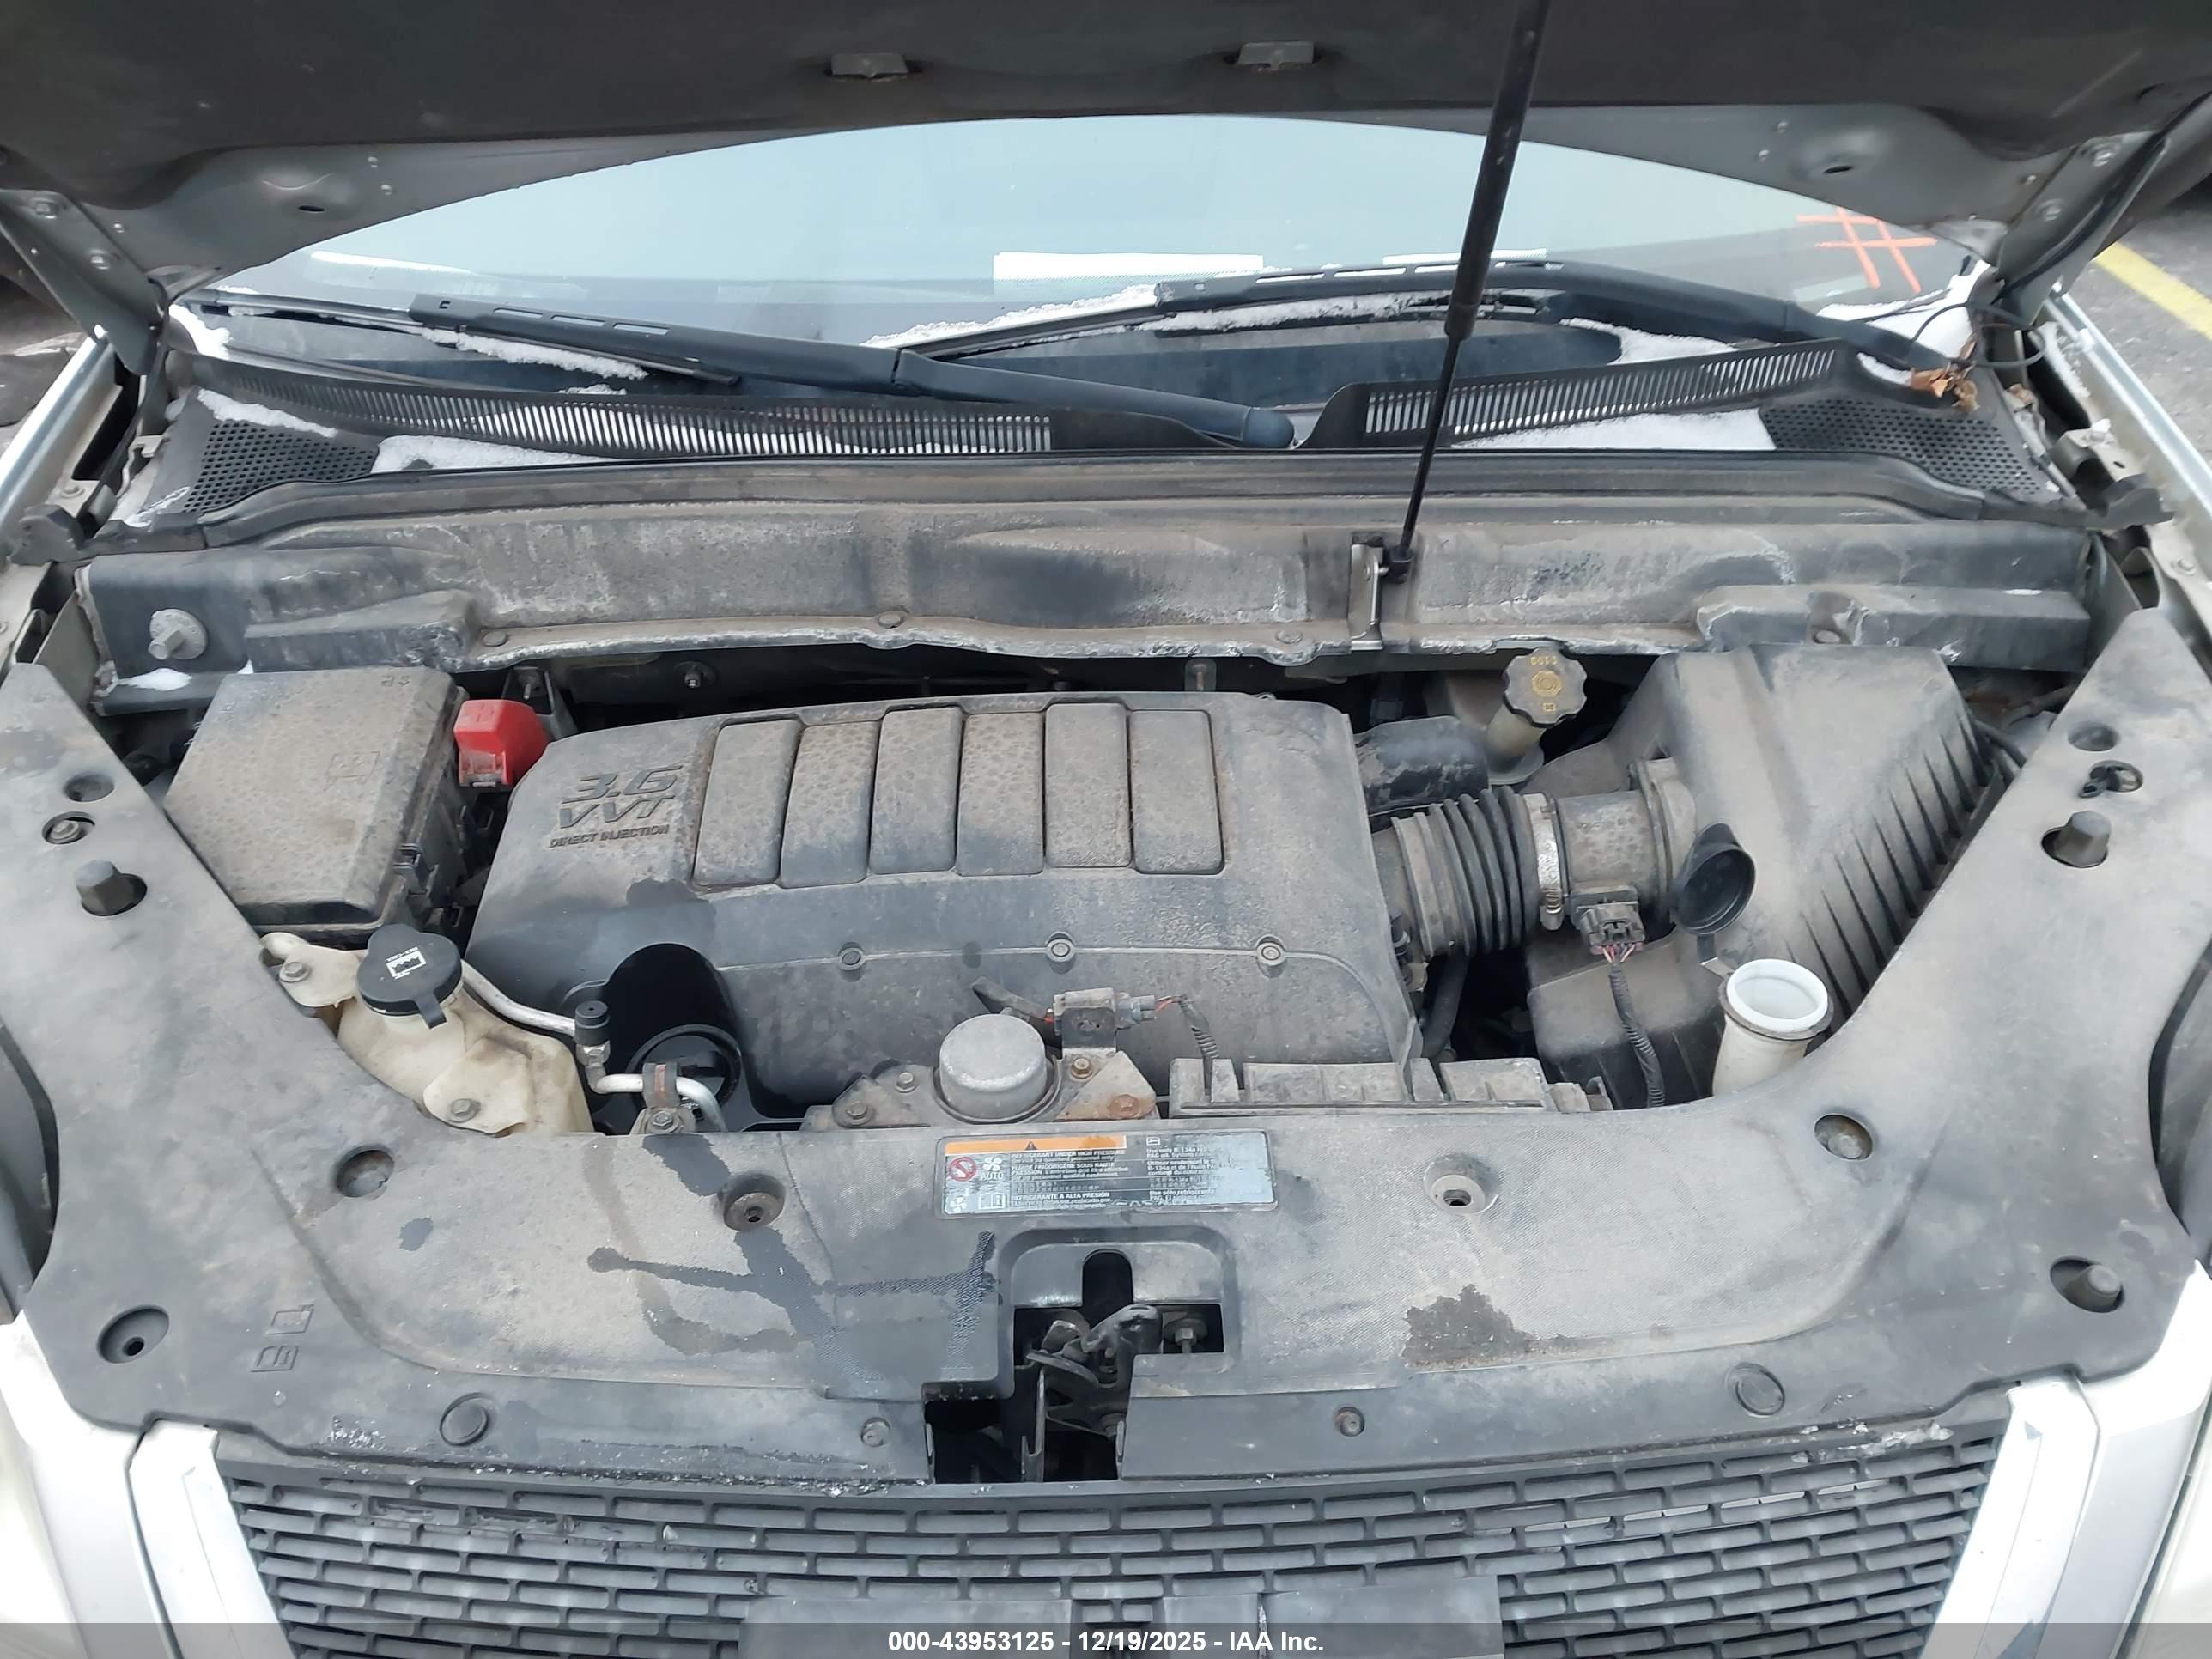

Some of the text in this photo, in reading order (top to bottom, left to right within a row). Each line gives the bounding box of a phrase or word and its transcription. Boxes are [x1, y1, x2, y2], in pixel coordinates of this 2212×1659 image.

[561, 764, 684, 805] 3.6
[559, 794, 677, 830] VVT
[550, 824, 671, 848] DIRECT INJECTION
